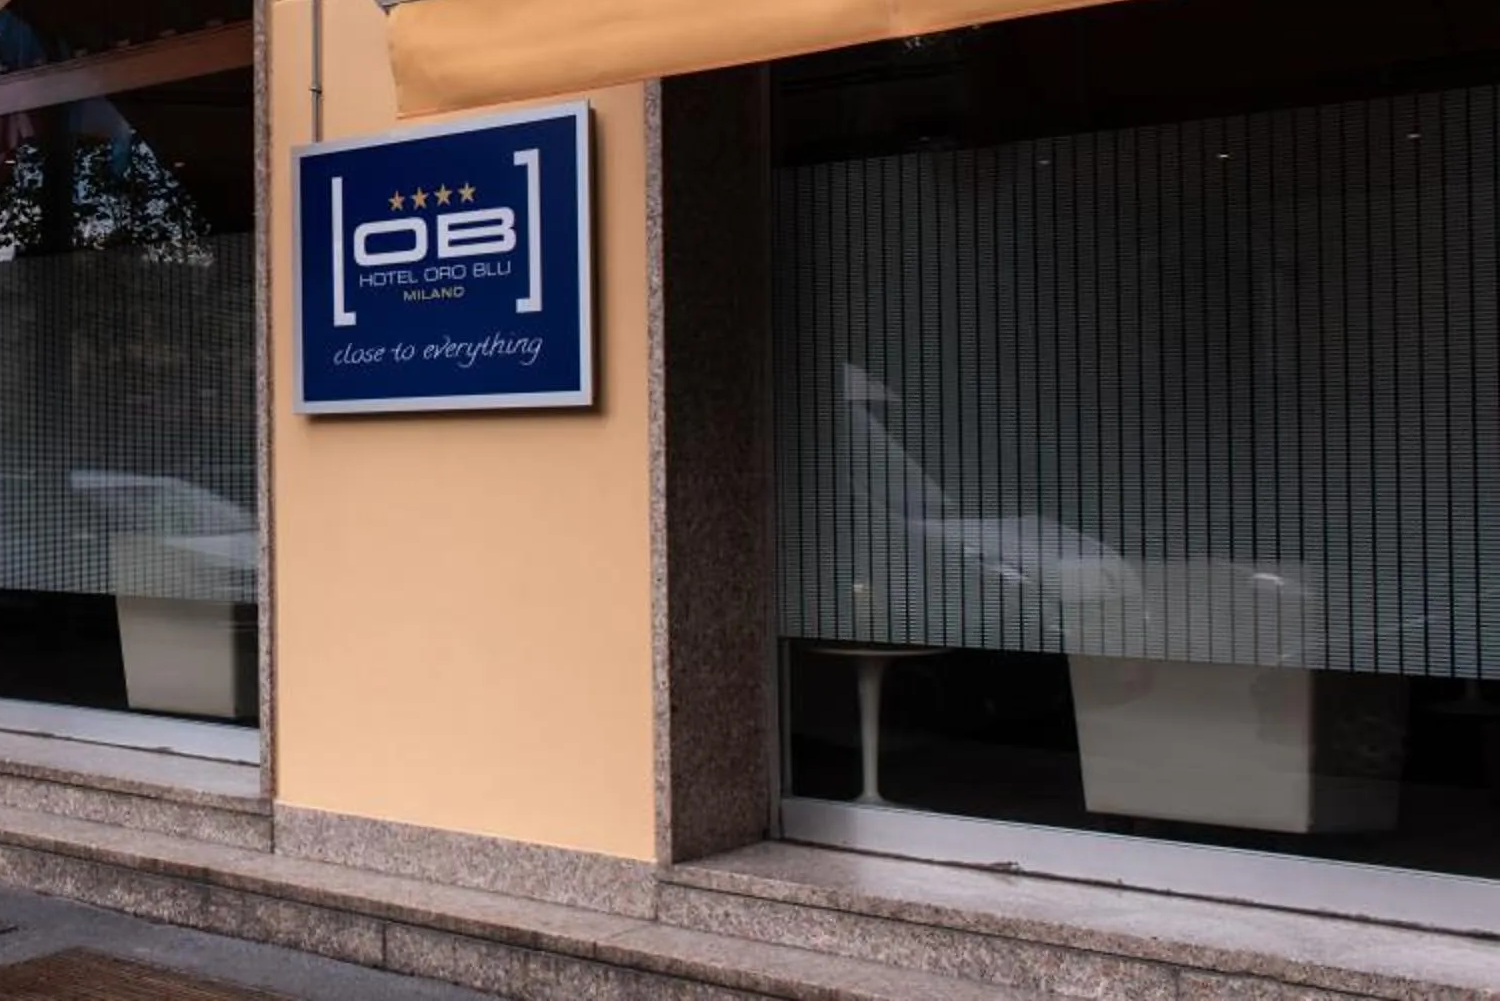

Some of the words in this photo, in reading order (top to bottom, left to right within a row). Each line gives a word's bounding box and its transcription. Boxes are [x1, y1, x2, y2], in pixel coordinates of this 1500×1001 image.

[353, 207, 516, 266] OB
[359, 269, 418, 288] HOTEL
[423, 264, 466, 282] ORO
[473, 260, 511, 278] BLU
[403, 286, 465, 302] MILANO
[333, 342, 384, 366] close
[390, 342, 414, 362] to
[423, 331, 544, 369] everything
